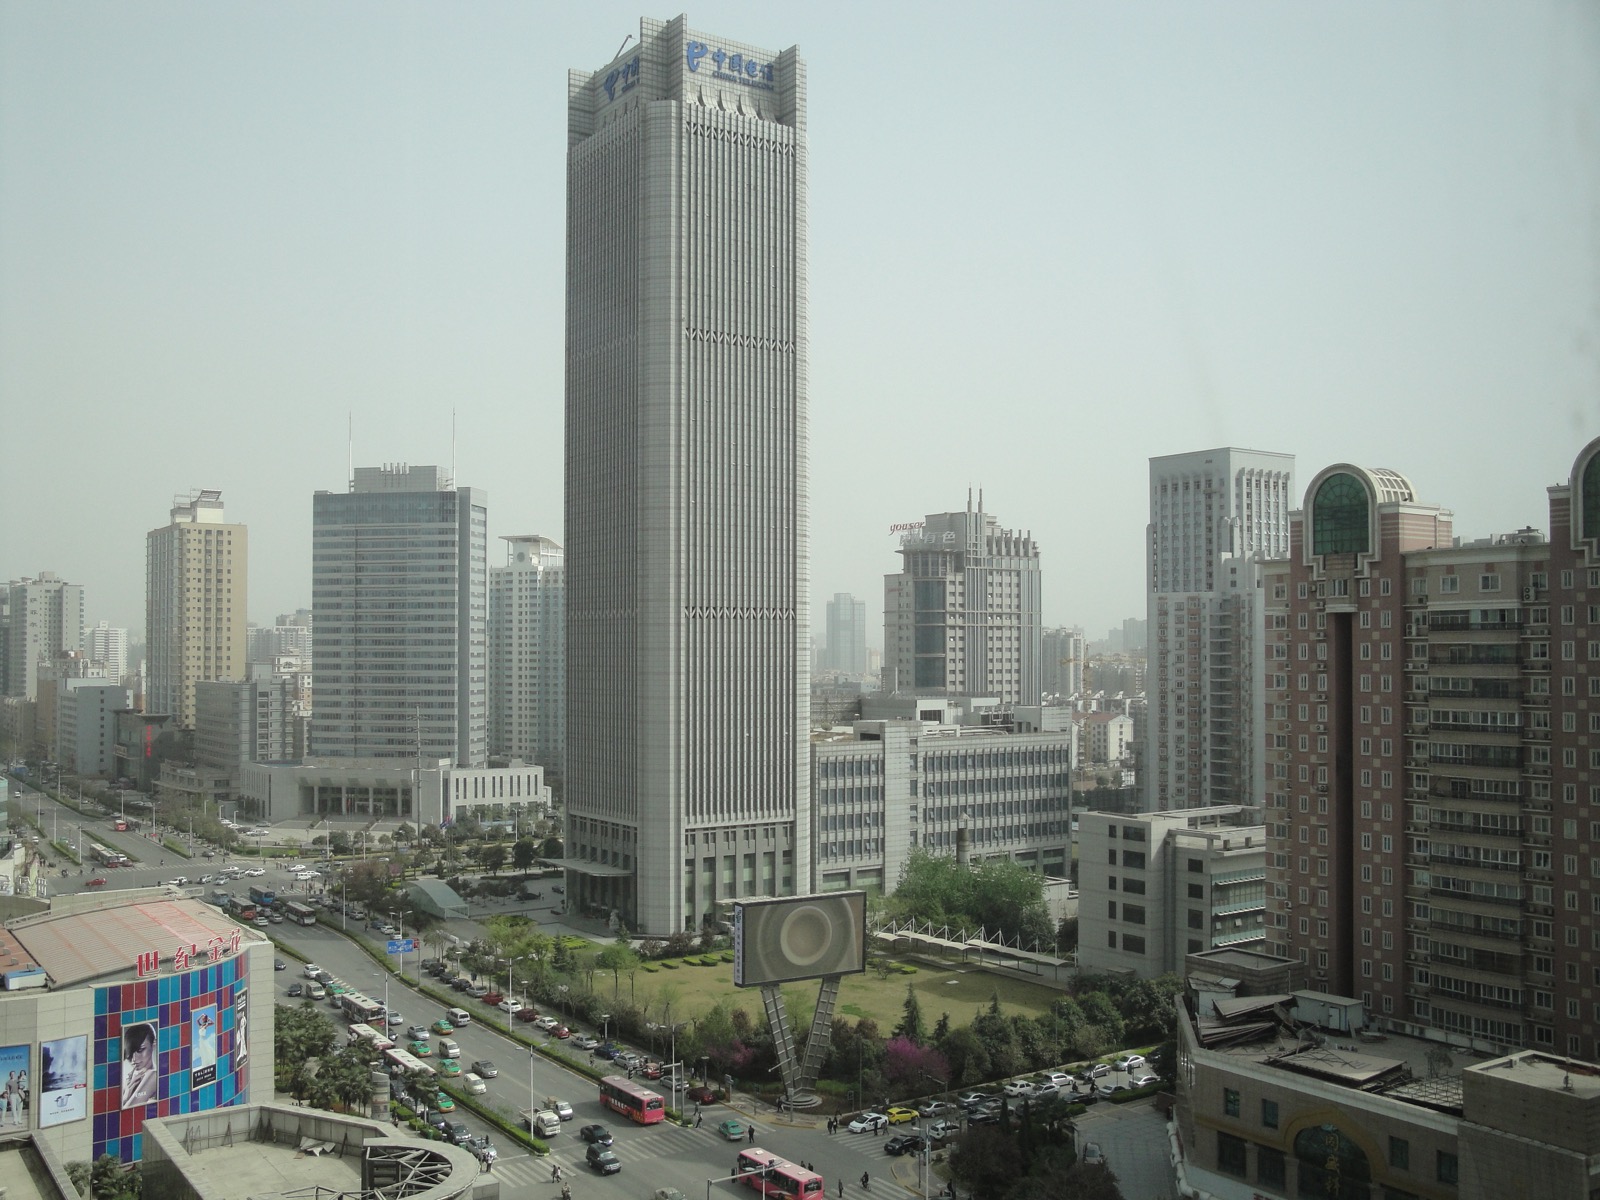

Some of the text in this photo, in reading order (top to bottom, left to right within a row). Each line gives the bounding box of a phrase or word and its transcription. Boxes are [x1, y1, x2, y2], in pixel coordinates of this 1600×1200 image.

[712, 48, 774, 82] 中国电信
[136, 927, 241, 977] 世纪金花
